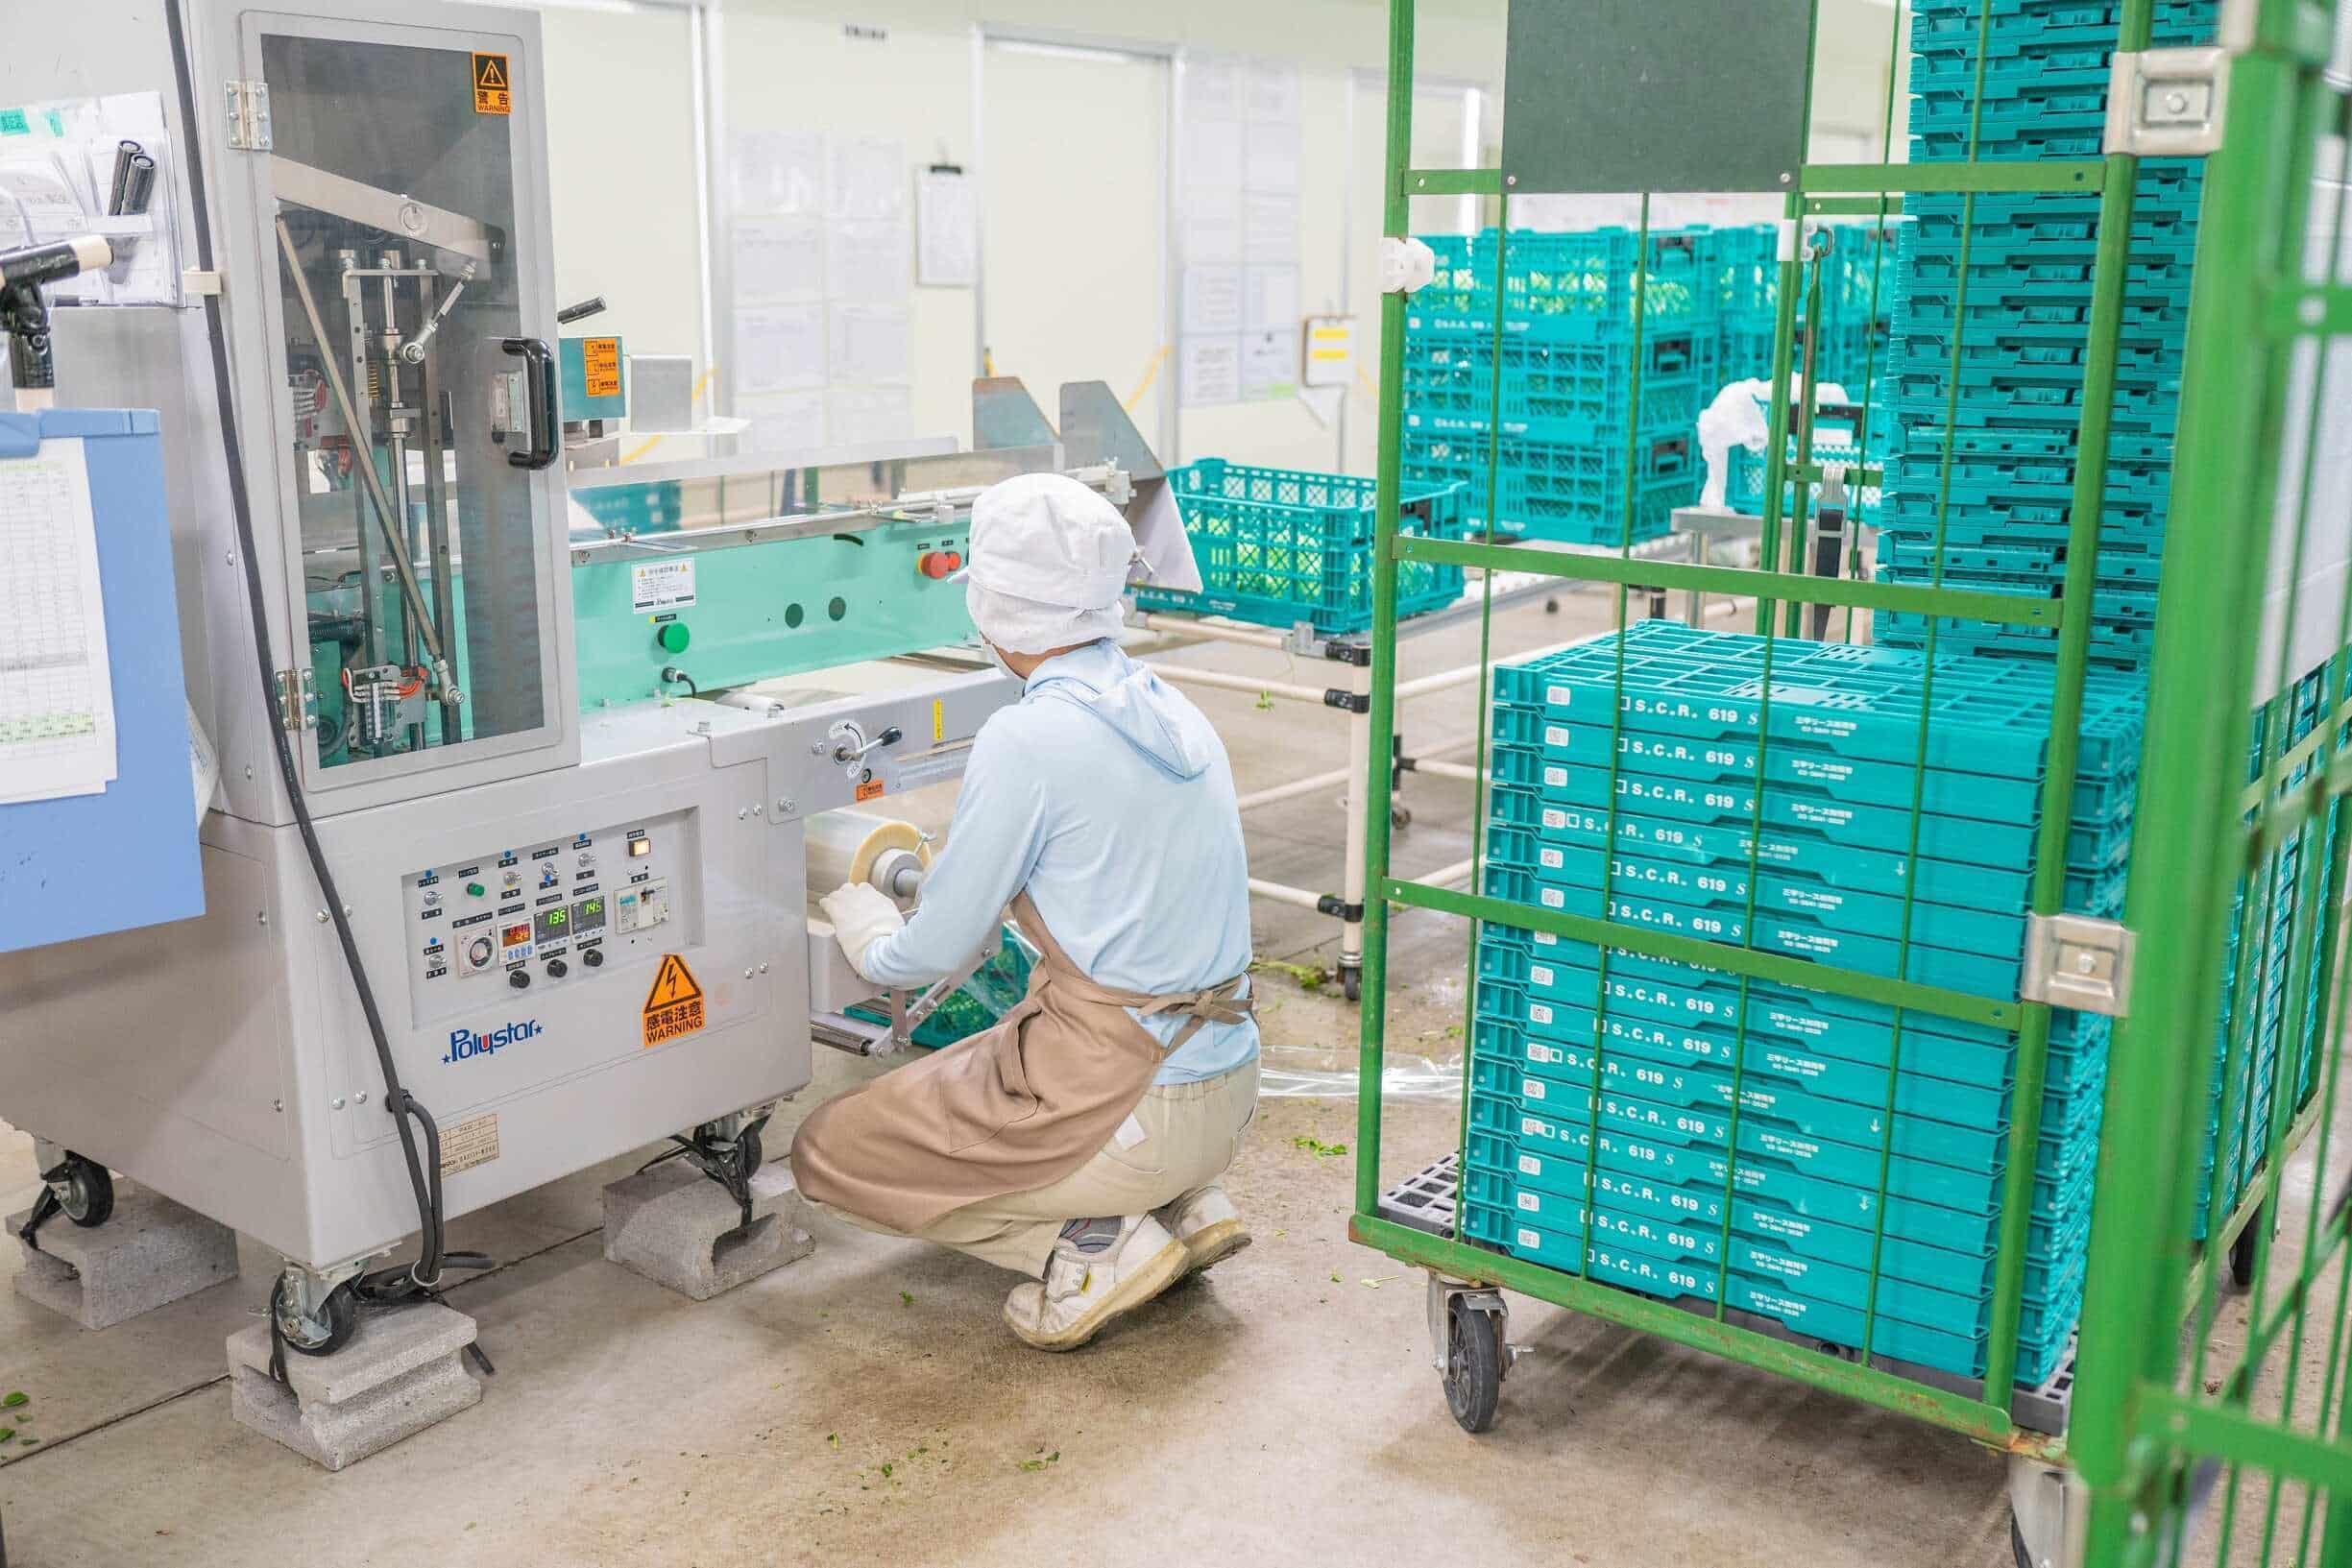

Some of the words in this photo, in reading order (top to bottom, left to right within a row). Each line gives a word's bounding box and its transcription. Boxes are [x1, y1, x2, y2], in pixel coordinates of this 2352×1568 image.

[478, 105, 511, 113] WARNING
[1635, 699, 1698, 718] S.C.R.
[1709, 708, 1738, 723] 619
[1633, 740, 1695, 760] S.C.R.
[1705, 750, 1735, 766] 619
[1632, 783, 1694, 804] S.C.R.
[1705, 793, 1734, 808] 619
[1655, 829, 1684, 844] 619
[1625, 865, 1687, 886] S.C.R.
[1697, 876, 1727, 892] 619
[548, 908, 567, 925] 135
[1620, 905, 1683, 928] S.C.R.
[1692, 917, 1722, 933] 619
[1614, 984, 1676, 1007] S.C.R.
[1685, 998, 1714, 1014] 619
[645, 1001, 701, 1030] 感電注意
[450, 1019, 537, 1062] Polystar
[645, 1016, 703, 1045] WARNING
[1612, 1023, 1672, 1047] S.C.R.
[1683, 1038, 1711, 1054] 619
[1636, 1068, 1664, 1085] 619
[1606, 1101, 1666, 1125] S.C.R.
[1677, 1117, 1706, 1134] 619
[1628, 1145, 1656, 1161] 619
[1601, 1177, 1661, 1202] S.C.R.
[1670, 1194, 1699, 1211] 619
[1597, 1216, 1657, 1241] S.C.R.
[1667, 1232, 1696, 1249] 619
[1600, 1253, 1658, 1279] S.C.R.
[1668, 1271, 1696, 1289] 619
